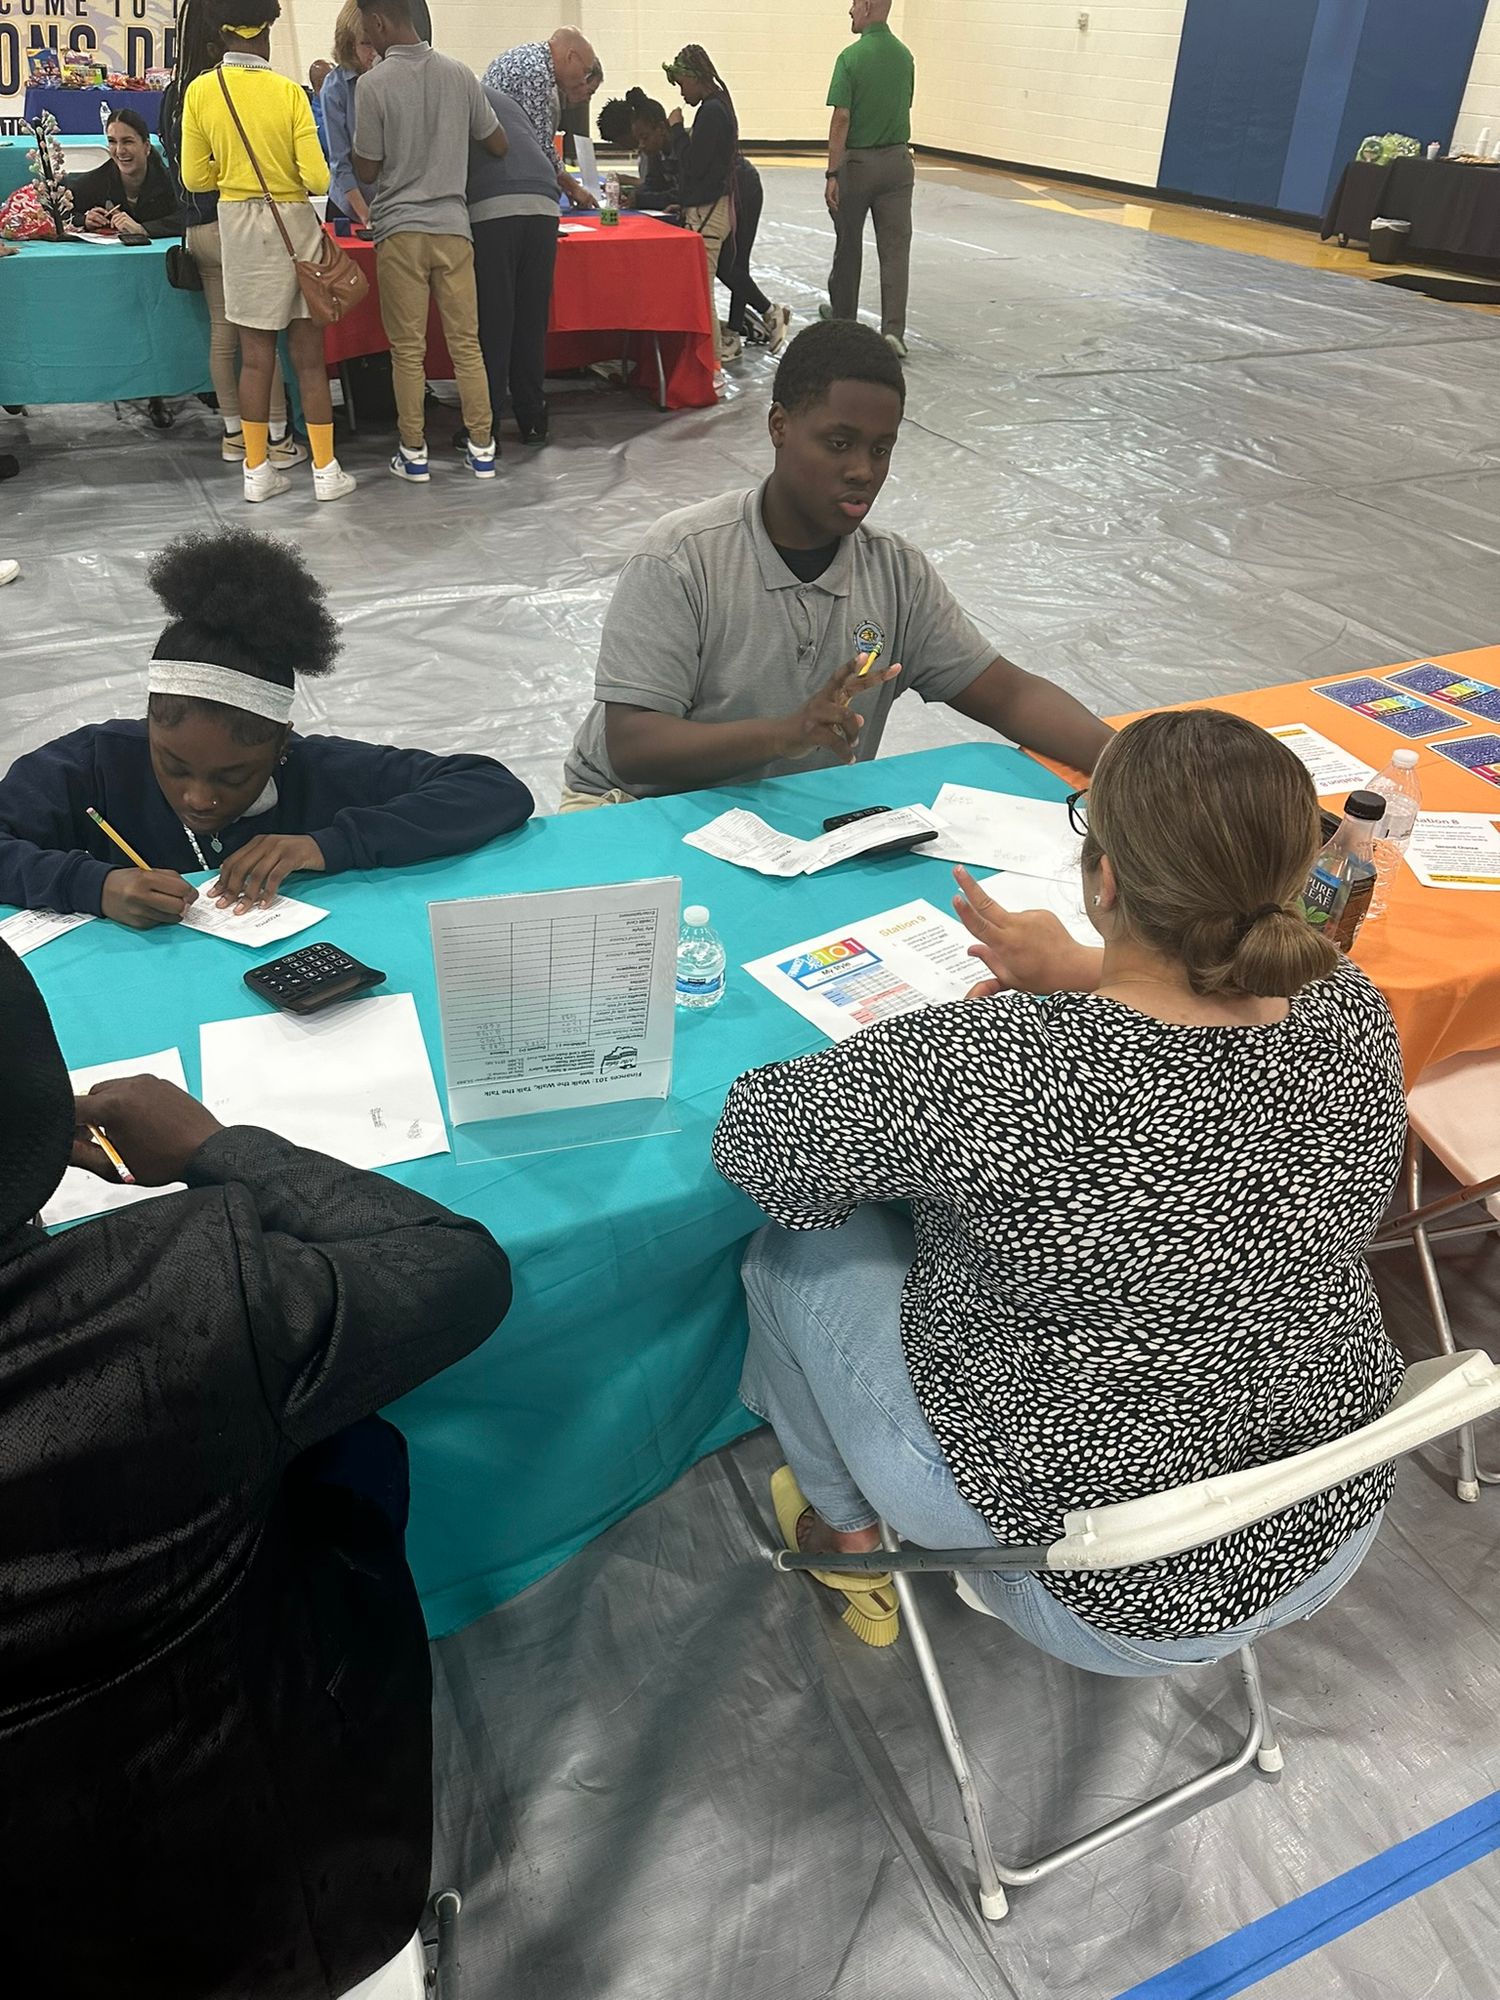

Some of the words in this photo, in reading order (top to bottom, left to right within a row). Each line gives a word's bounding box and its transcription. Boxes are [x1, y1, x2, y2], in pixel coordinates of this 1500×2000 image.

[1304, 888, 1331, 907] EAF
[879, 920, 920, 936] Station
[610, 1072, 642, 1081] Finances
[572, 1079, 591, 1087] Walk
